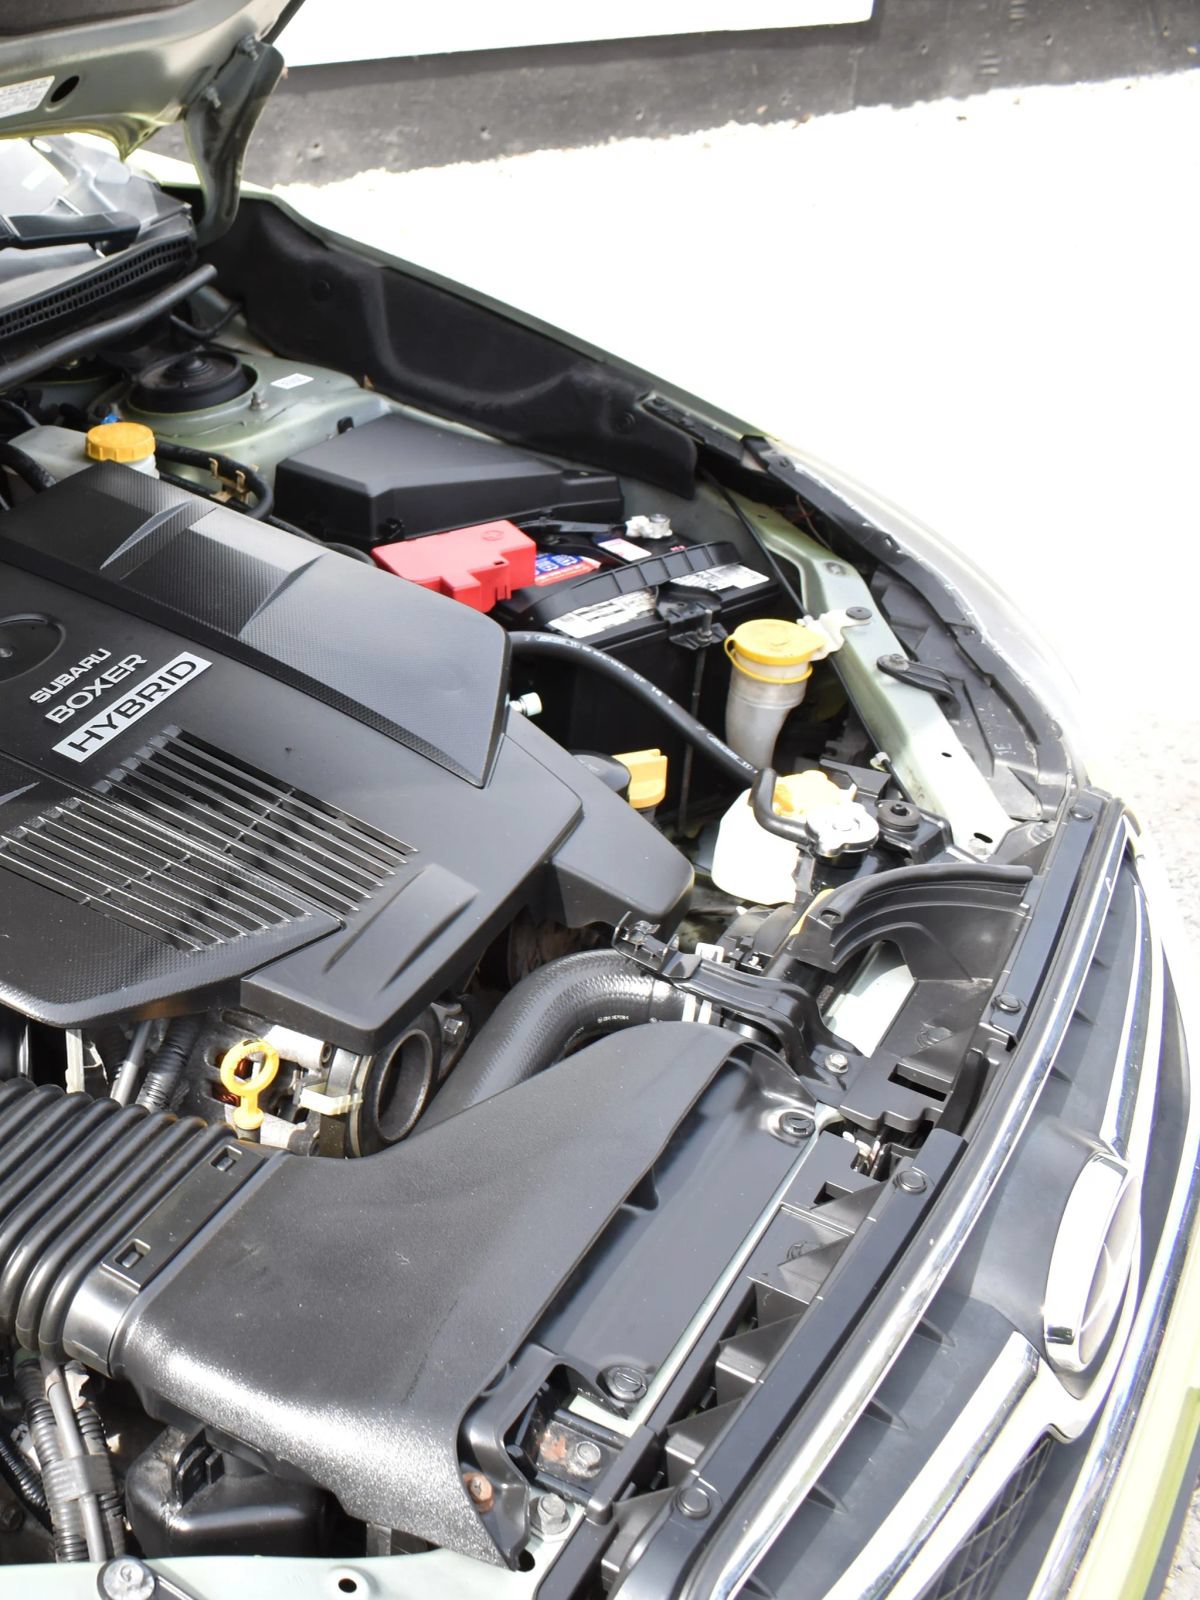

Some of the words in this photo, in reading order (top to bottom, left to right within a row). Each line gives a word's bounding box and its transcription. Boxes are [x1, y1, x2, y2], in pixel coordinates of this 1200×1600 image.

[29, 648, 112, 704] SUBARU
[45, 654, 148, 724] BOXER
[67, 660, 197, 753] HYBRID
